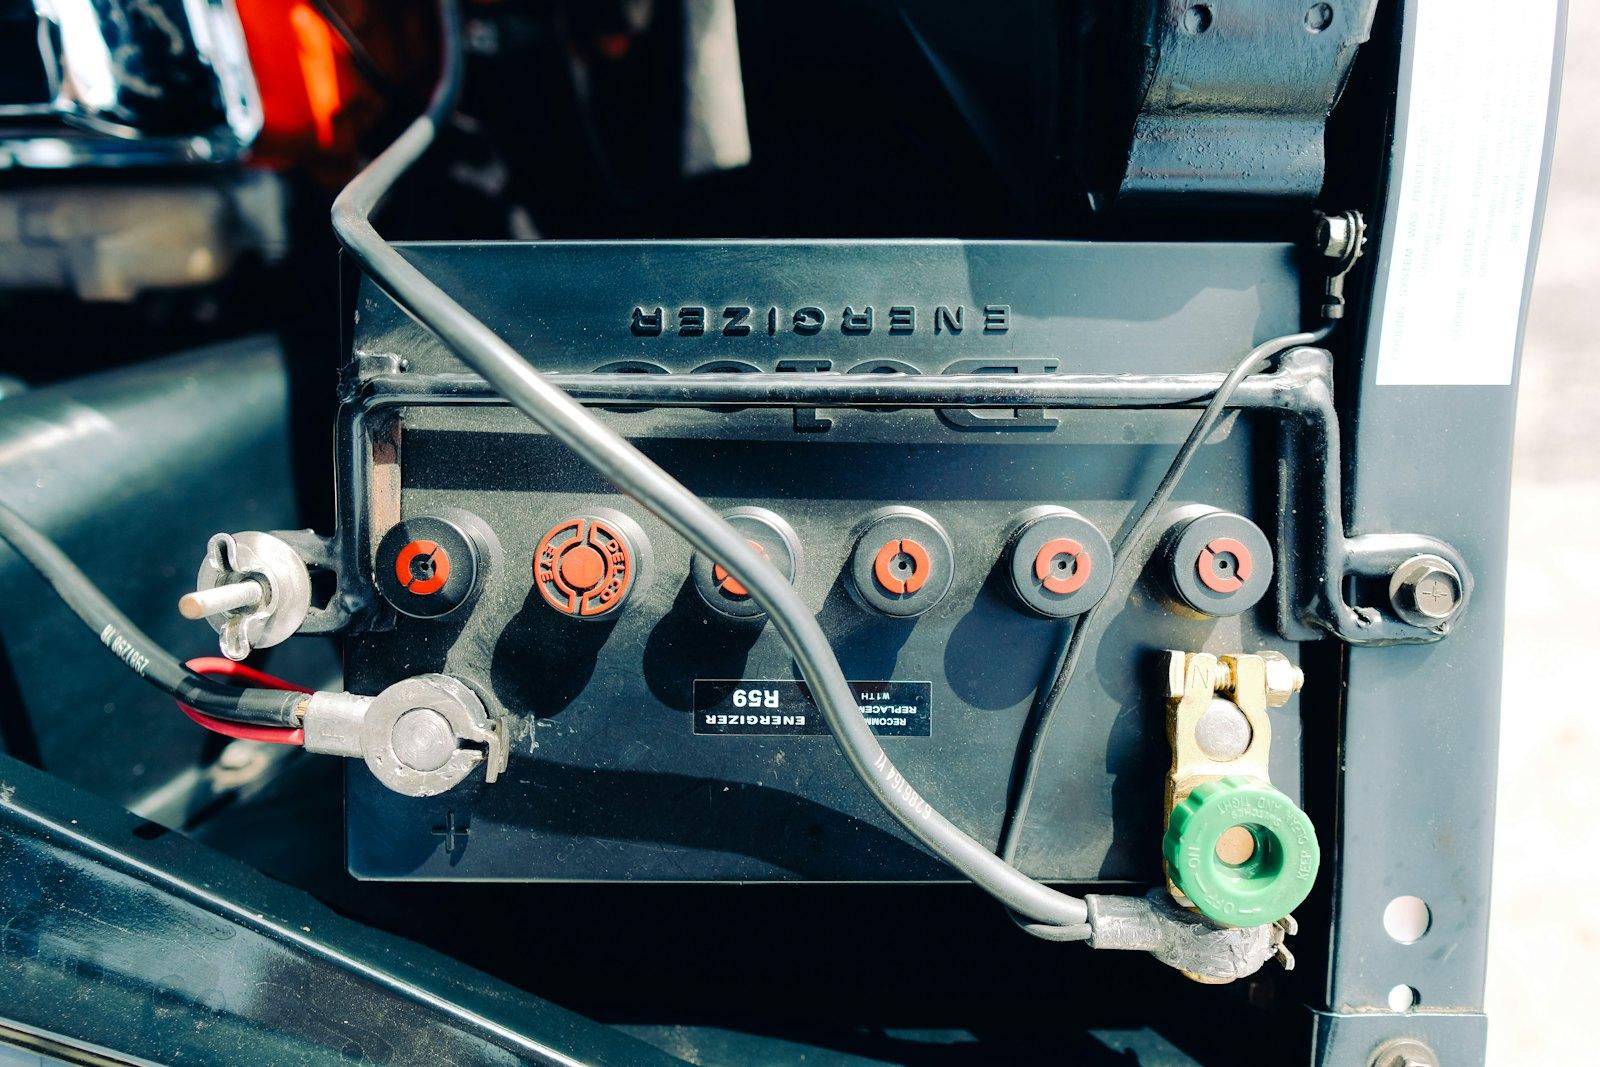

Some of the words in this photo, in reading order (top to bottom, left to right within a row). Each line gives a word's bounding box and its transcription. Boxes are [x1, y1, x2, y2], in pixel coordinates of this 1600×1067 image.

[629, 304, 1011, 338] ENERGIZER
[732, 688, 780, 709] R59
[704, 714, 806, 727] ENERGIZER
